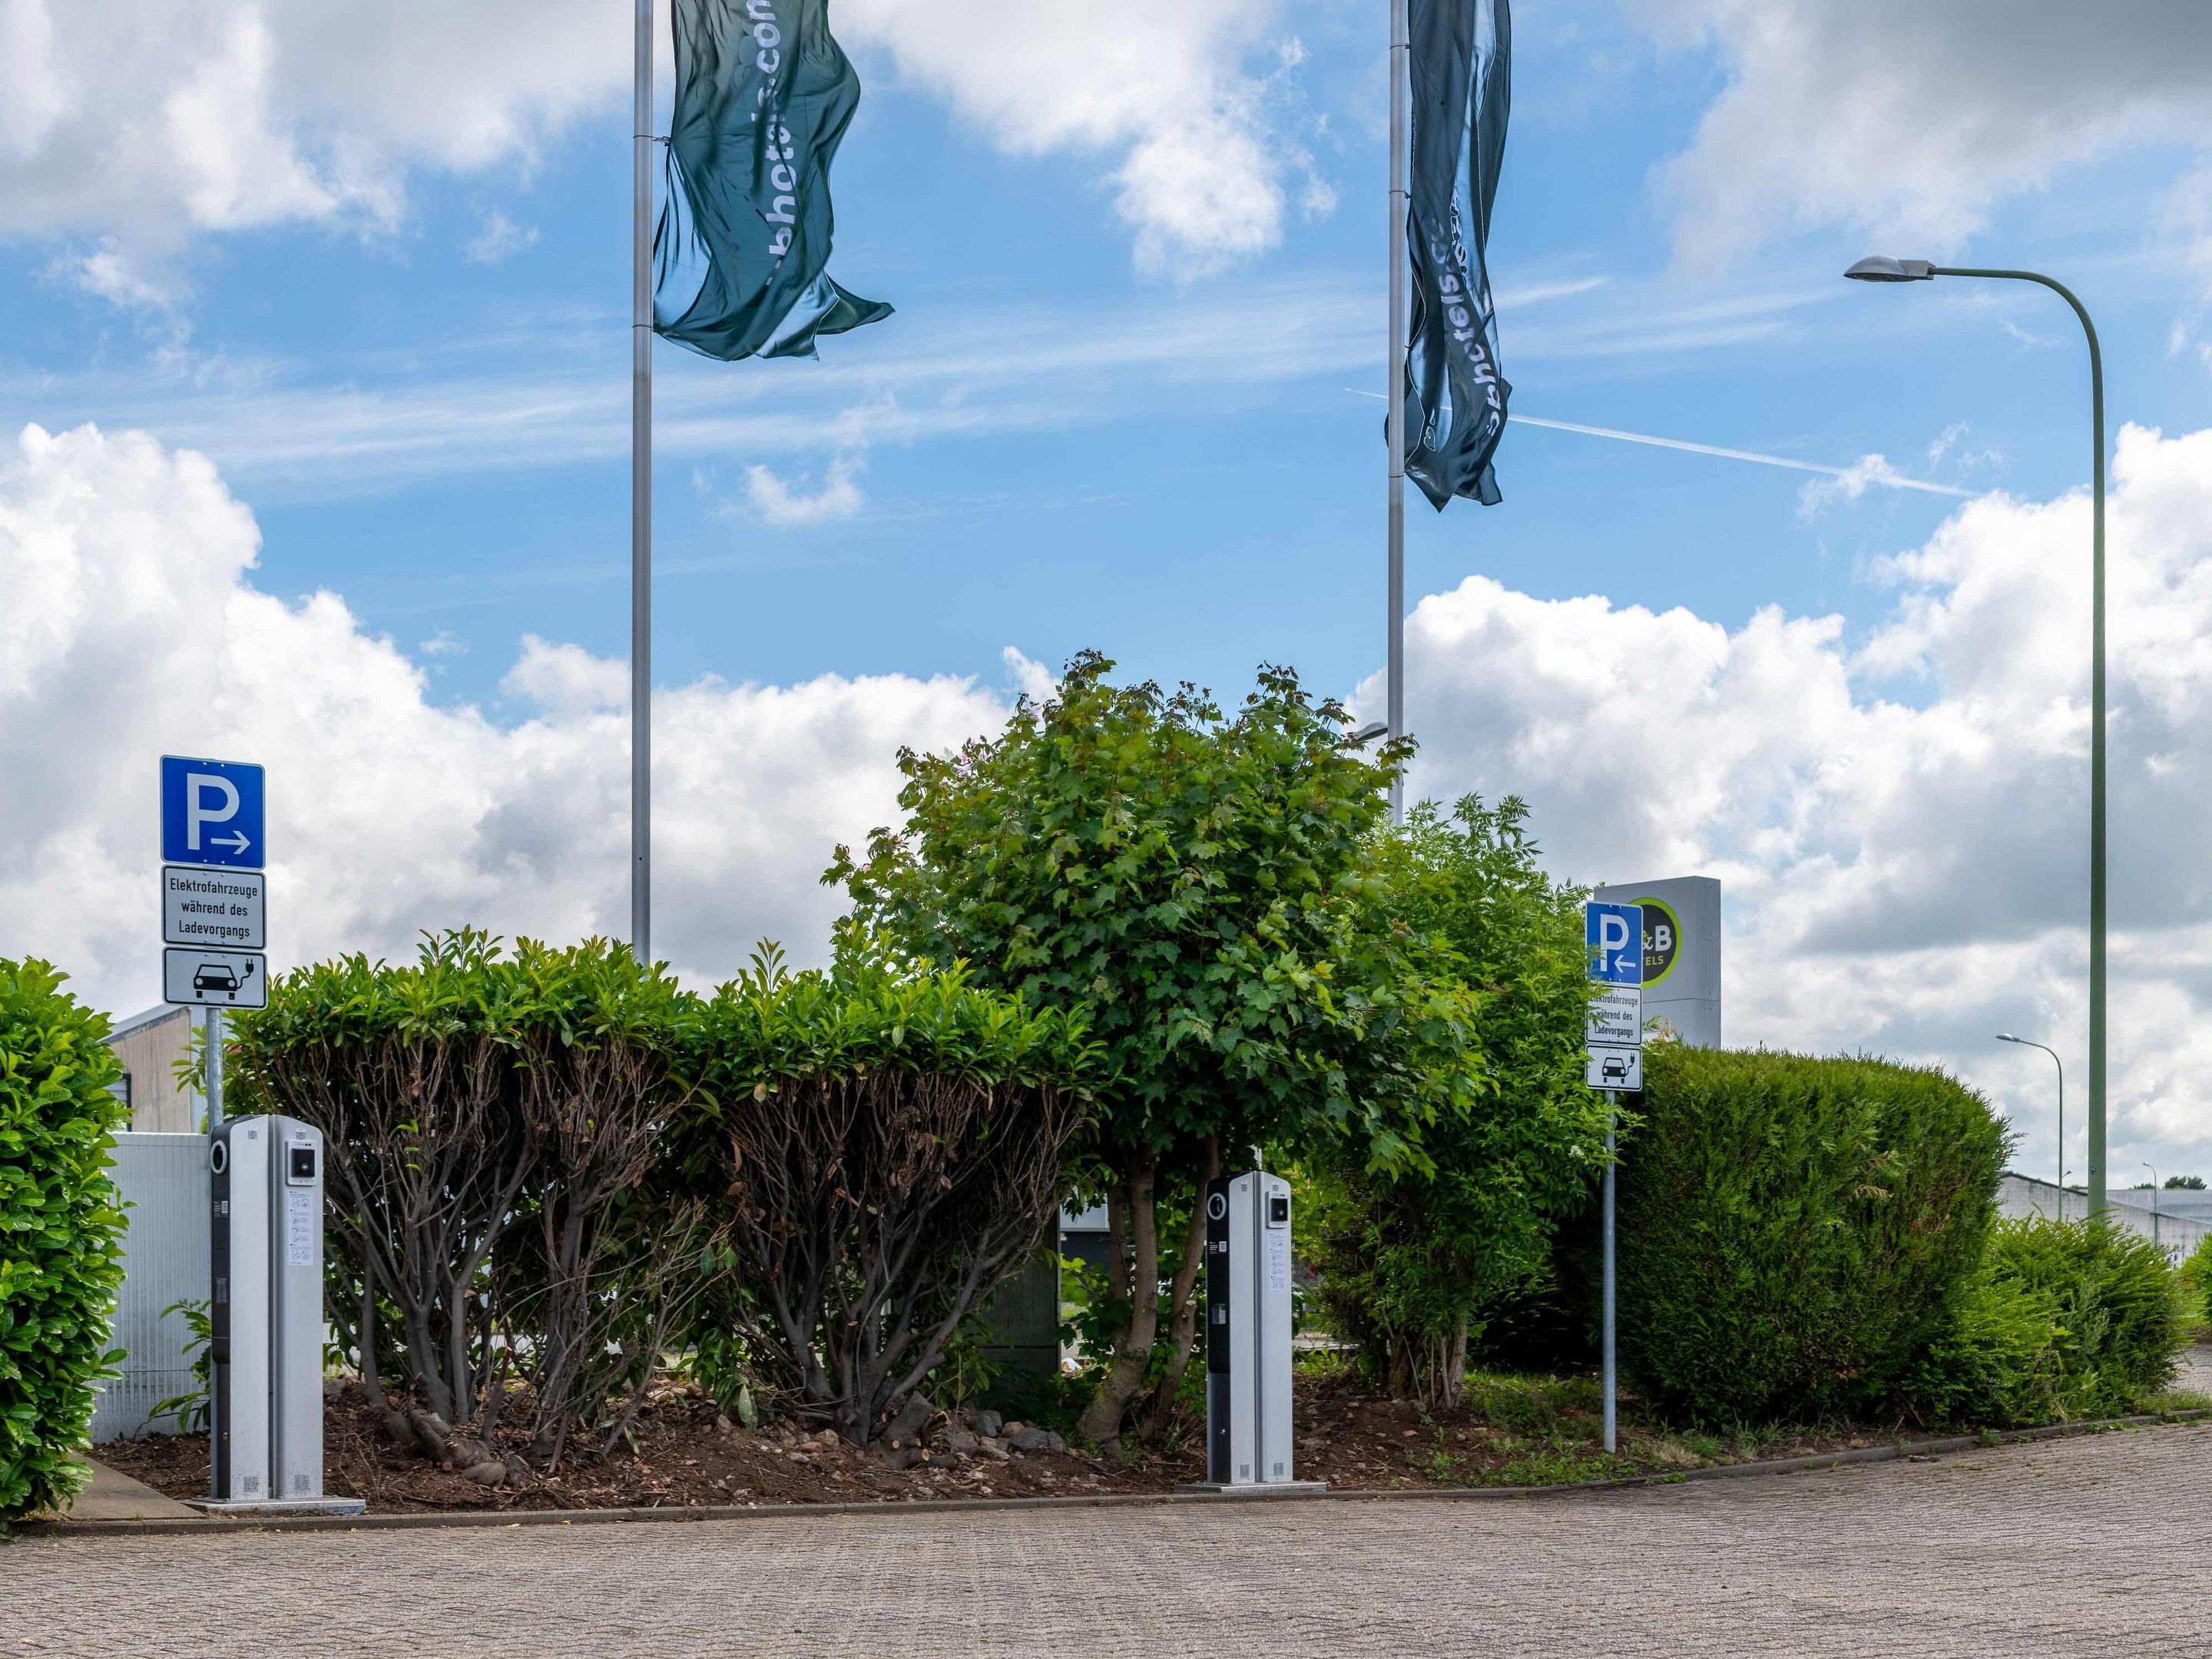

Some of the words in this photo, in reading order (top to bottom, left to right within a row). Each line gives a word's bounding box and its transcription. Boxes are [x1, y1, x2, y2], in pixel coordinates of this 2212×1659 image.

[187, 773, 240, 850] P
[170, 878, 258, 899] Elektrofahrzeuge
[180, 900, 225, 915] während
[230, 903, 248, 916] des
[178, 920, 250, 940] Ladevorgangs
[1600, 913, 1630, 972] P
[1622, 1011, 1633, 1021] des
[1594, 1025, 1634, 1038] Ladevorgangs
